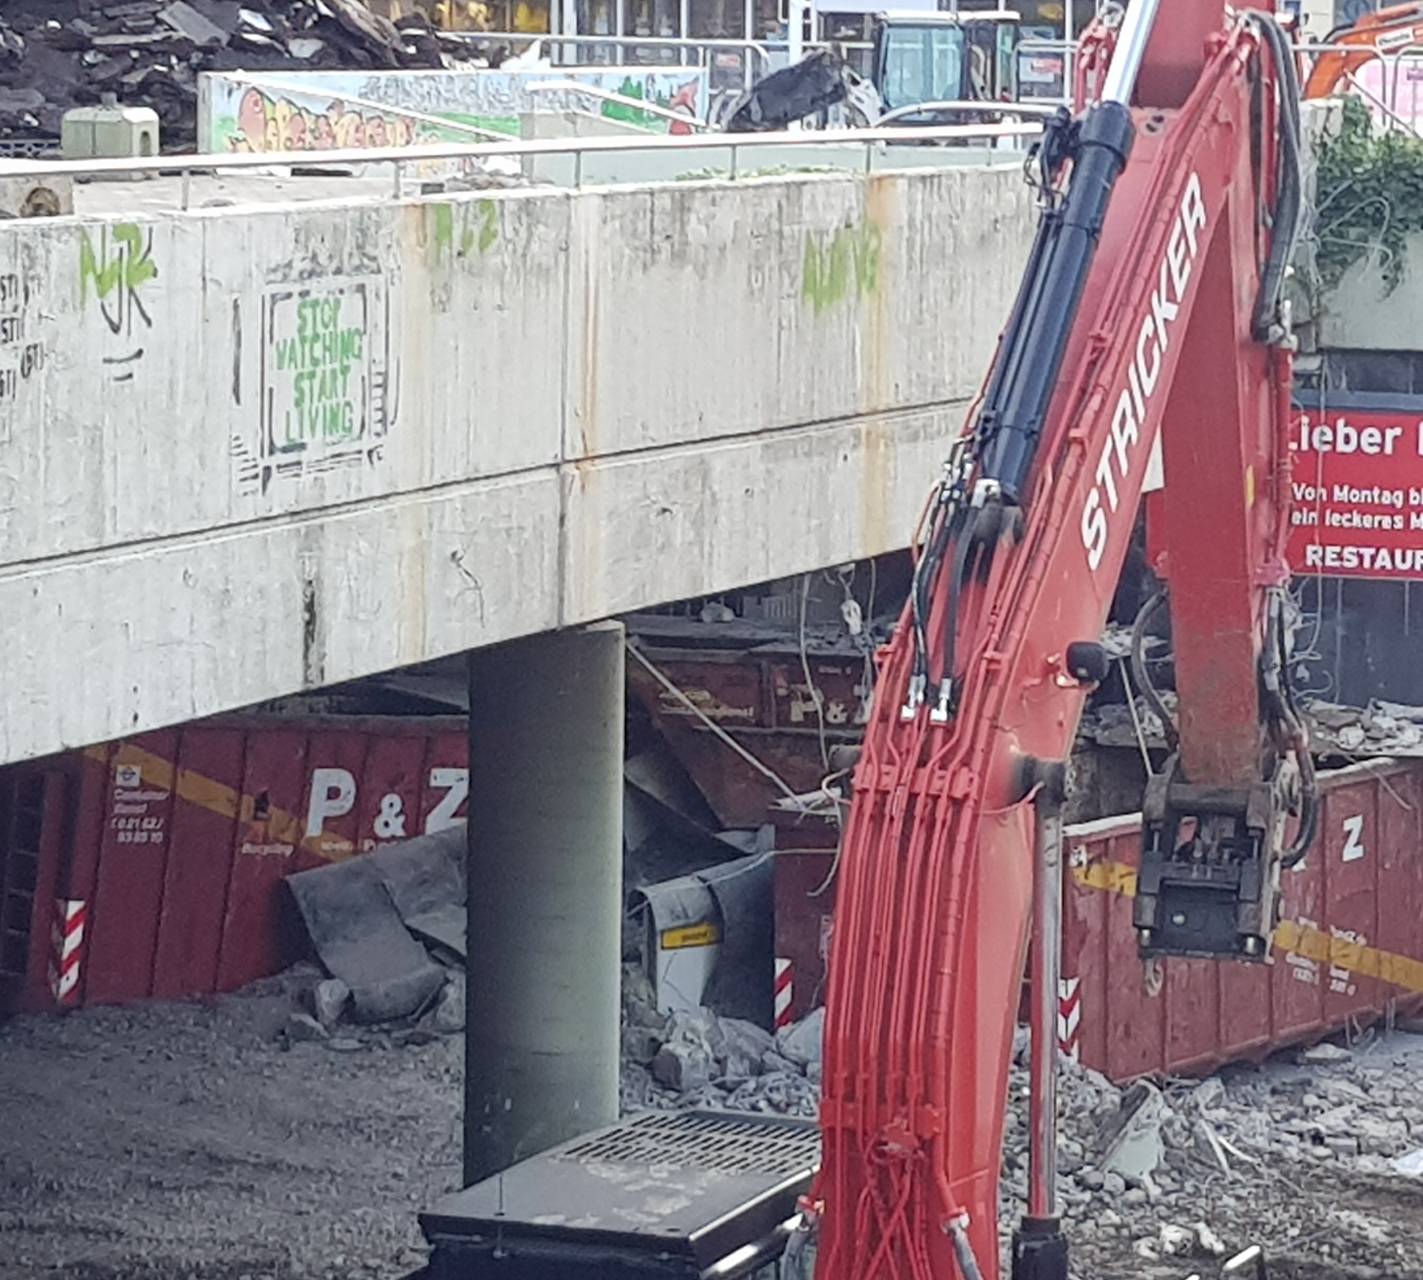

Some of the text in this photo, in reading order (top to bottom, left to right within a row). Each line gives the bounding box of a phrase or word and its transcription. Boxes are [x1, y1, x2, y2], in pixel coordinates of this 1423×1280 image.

[294, 366, 351, 408] START
[1081, 171, 1206, 571] STRICKER
[285, 400, 353, 443] LIVING
[1290, 416, 1402, 454] ieber
[1292, 482, 1328, 501] Von
[1333, 485, 1403, 508] Montag
[1291, 508, 1318, 526] ein
[1325, 509, 1403, 530] leckeres
[304, 767, 470, 839] P & Z
[1341, 814, 1365, 863] Z
